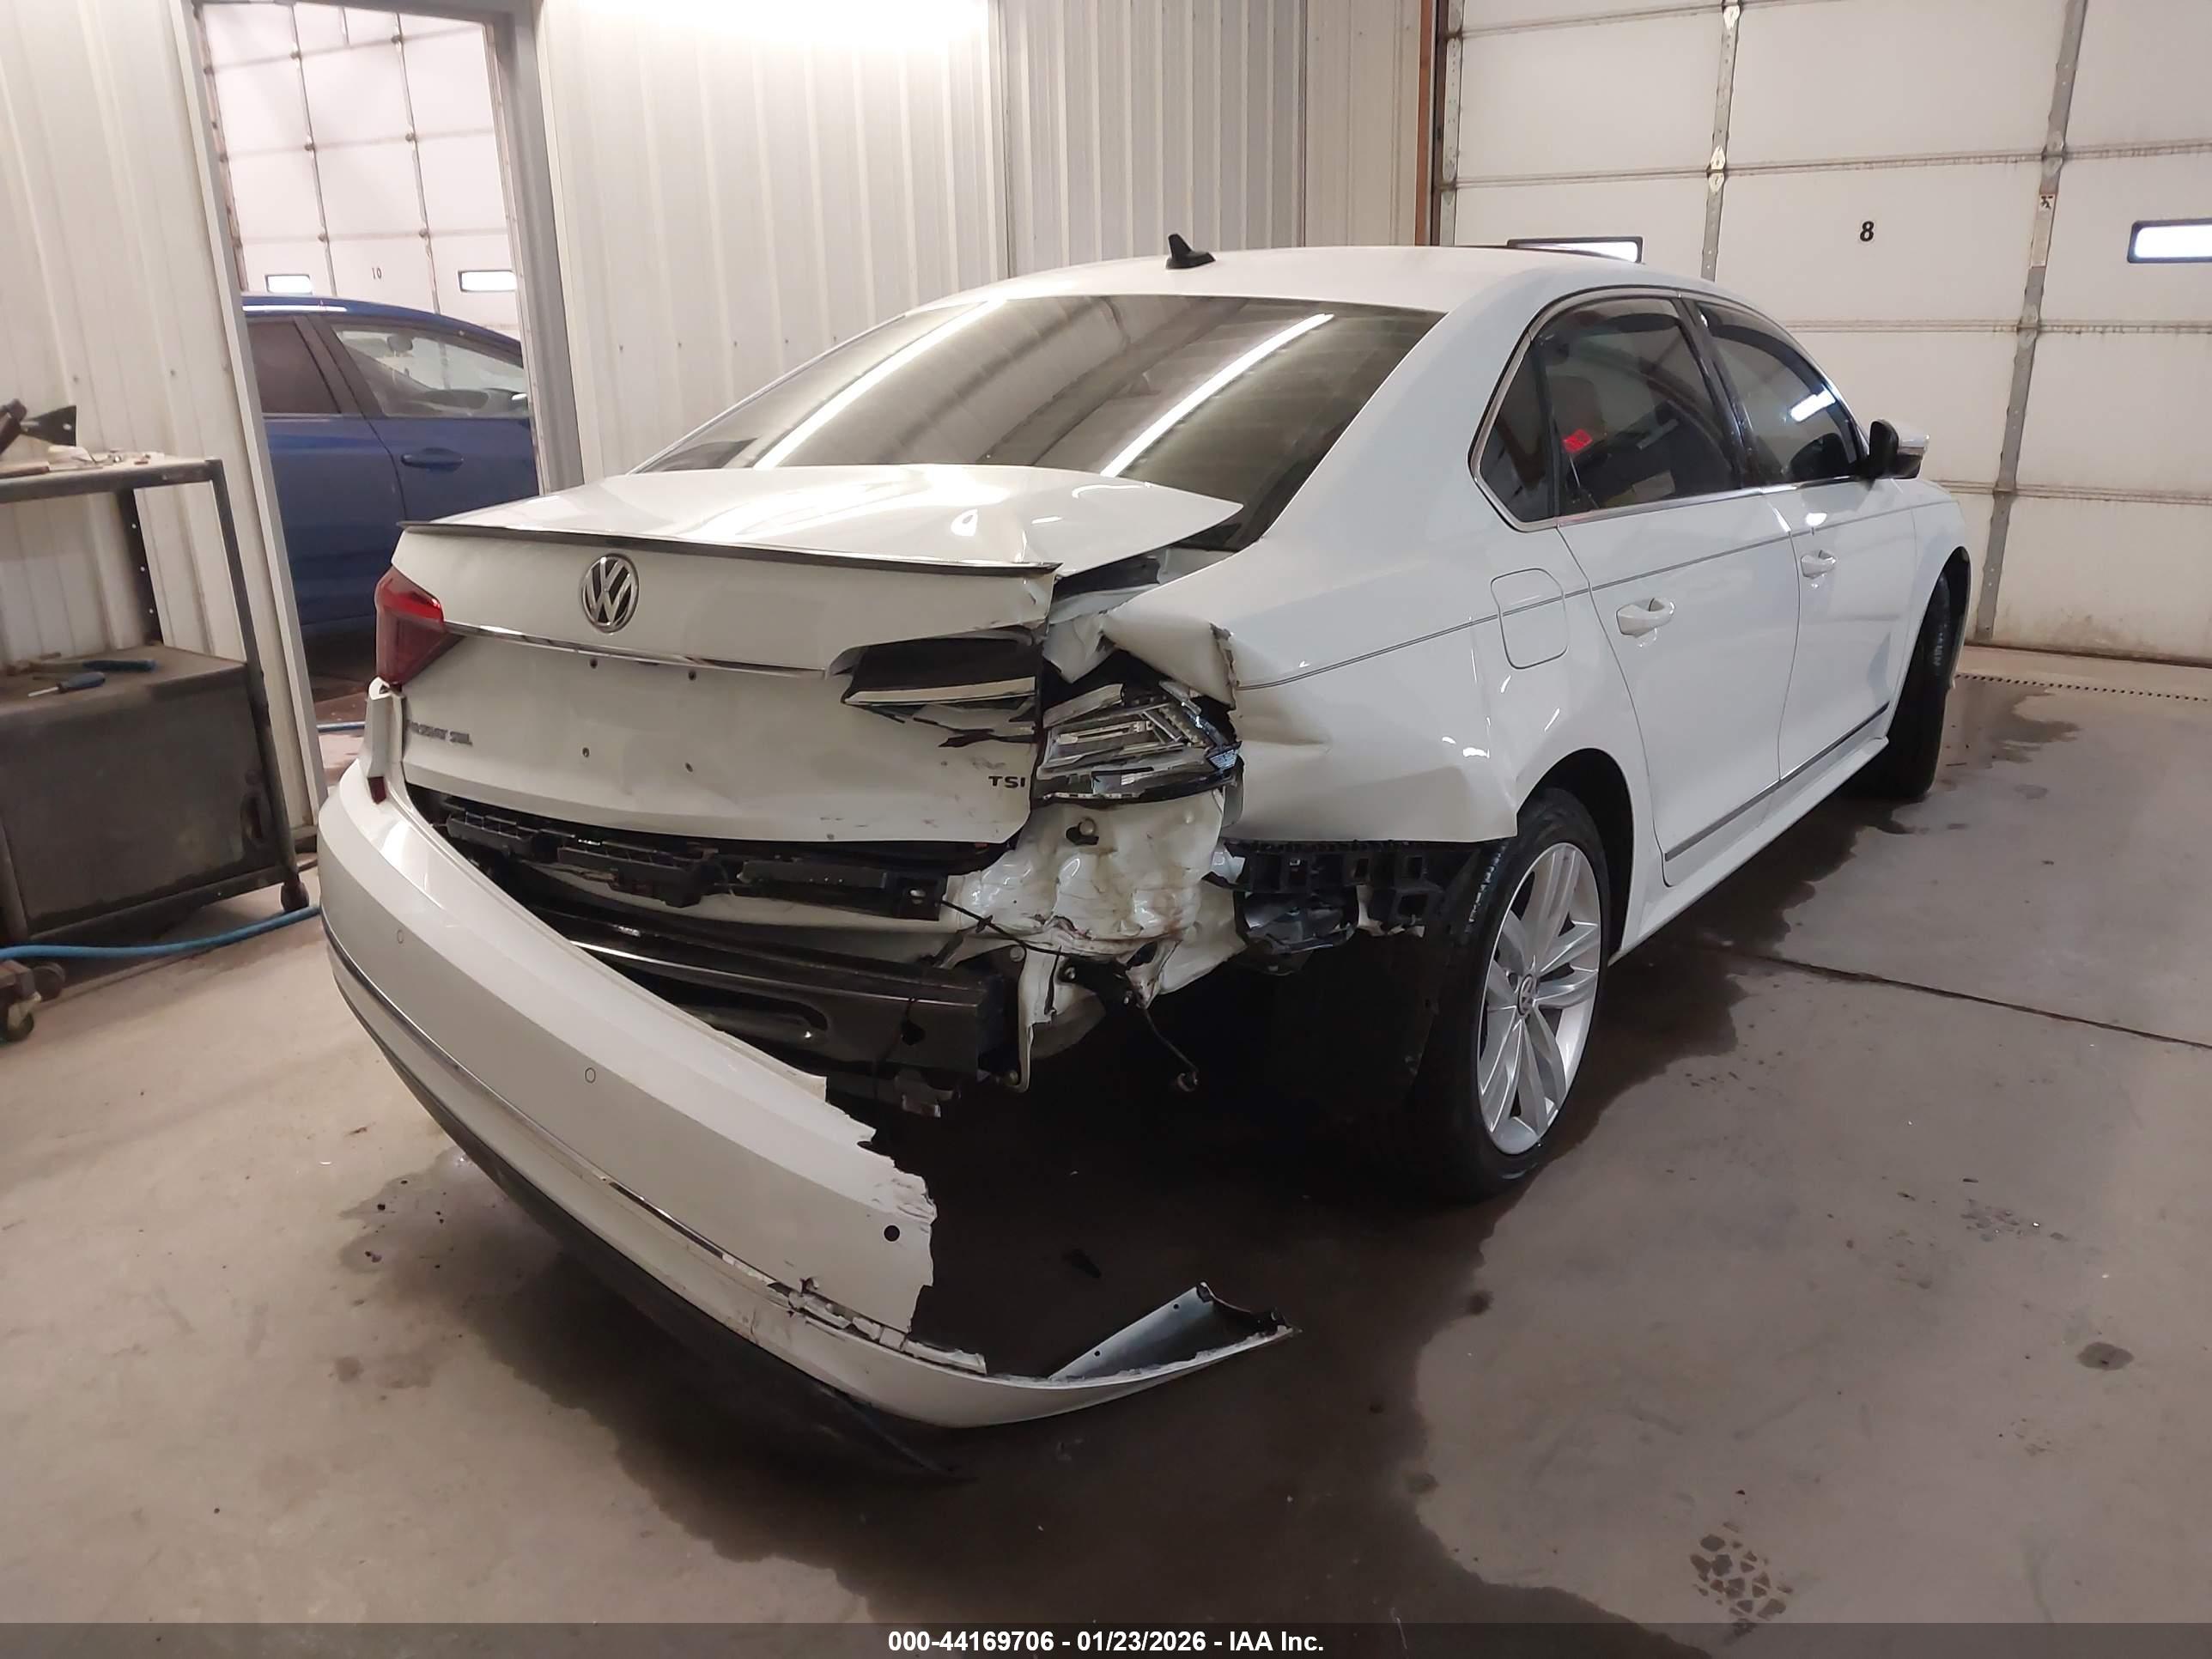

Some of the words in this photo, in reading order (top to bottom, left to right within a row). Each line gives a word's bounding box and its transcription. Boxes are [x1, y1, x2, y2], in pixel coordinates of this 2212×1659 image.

[1859, 220, 1875, 242] 8
[371, 266, 383, 280] 10
[581, 553, 639, 634] VW
[988, 775, 1026, 789] TSI
